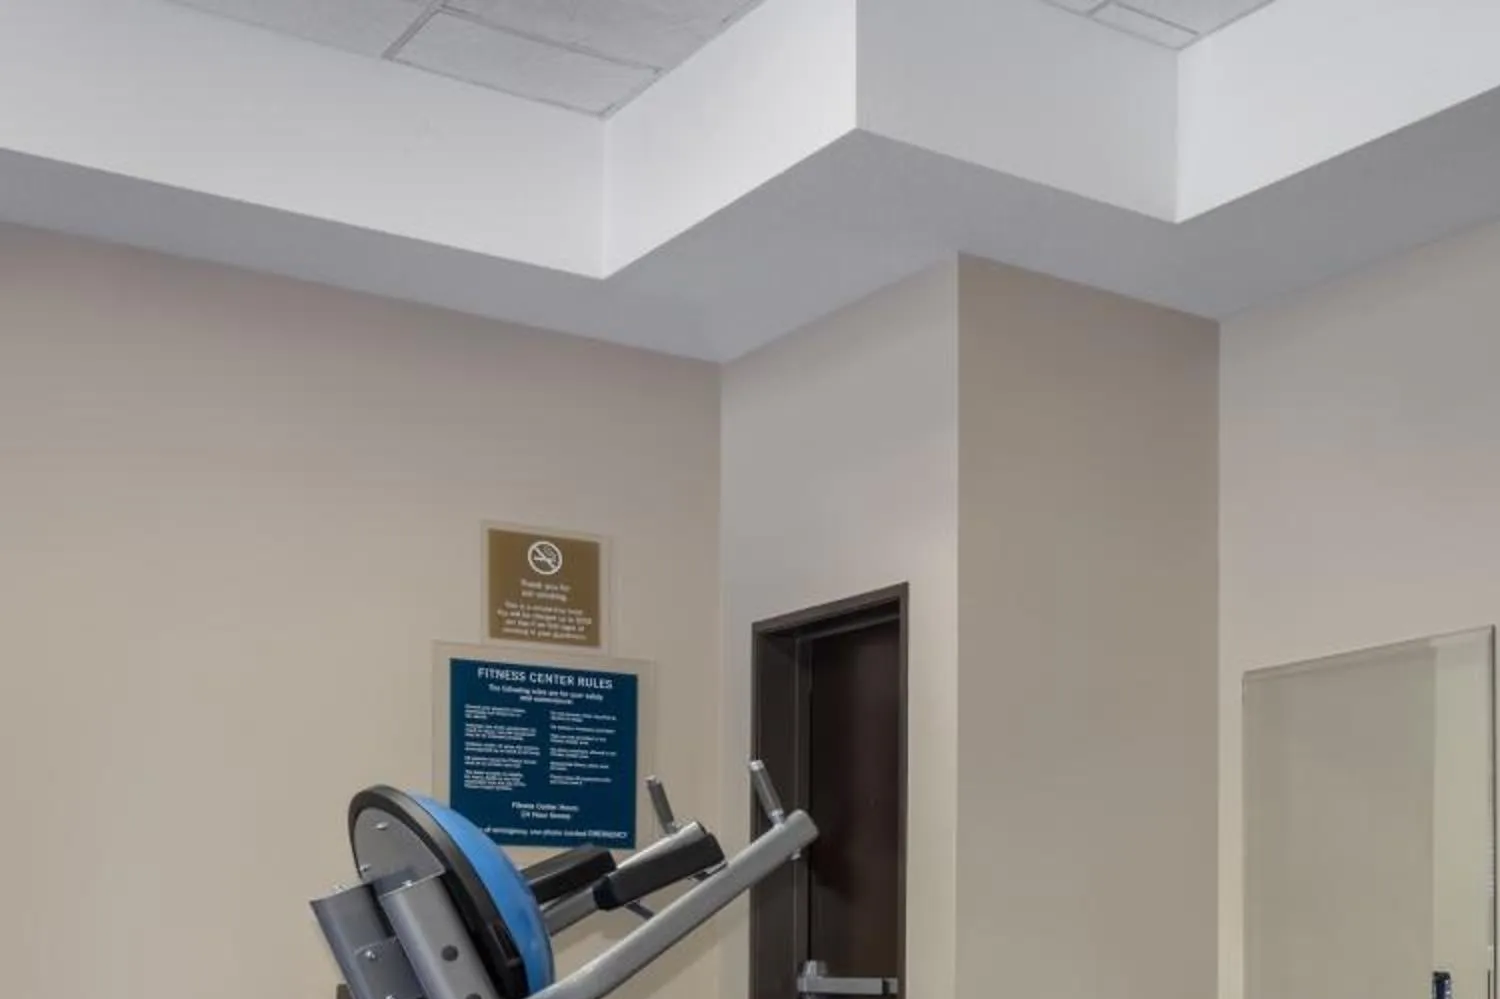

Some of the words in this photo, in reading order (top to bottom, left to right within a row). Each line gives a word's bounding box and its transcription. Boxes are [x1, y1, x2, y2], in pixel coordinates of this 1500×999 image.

[477, 667, 526, 681] FITNESS
[529, 671, 575, 686] CENTER
[577, 676, 613, 689] RULES
